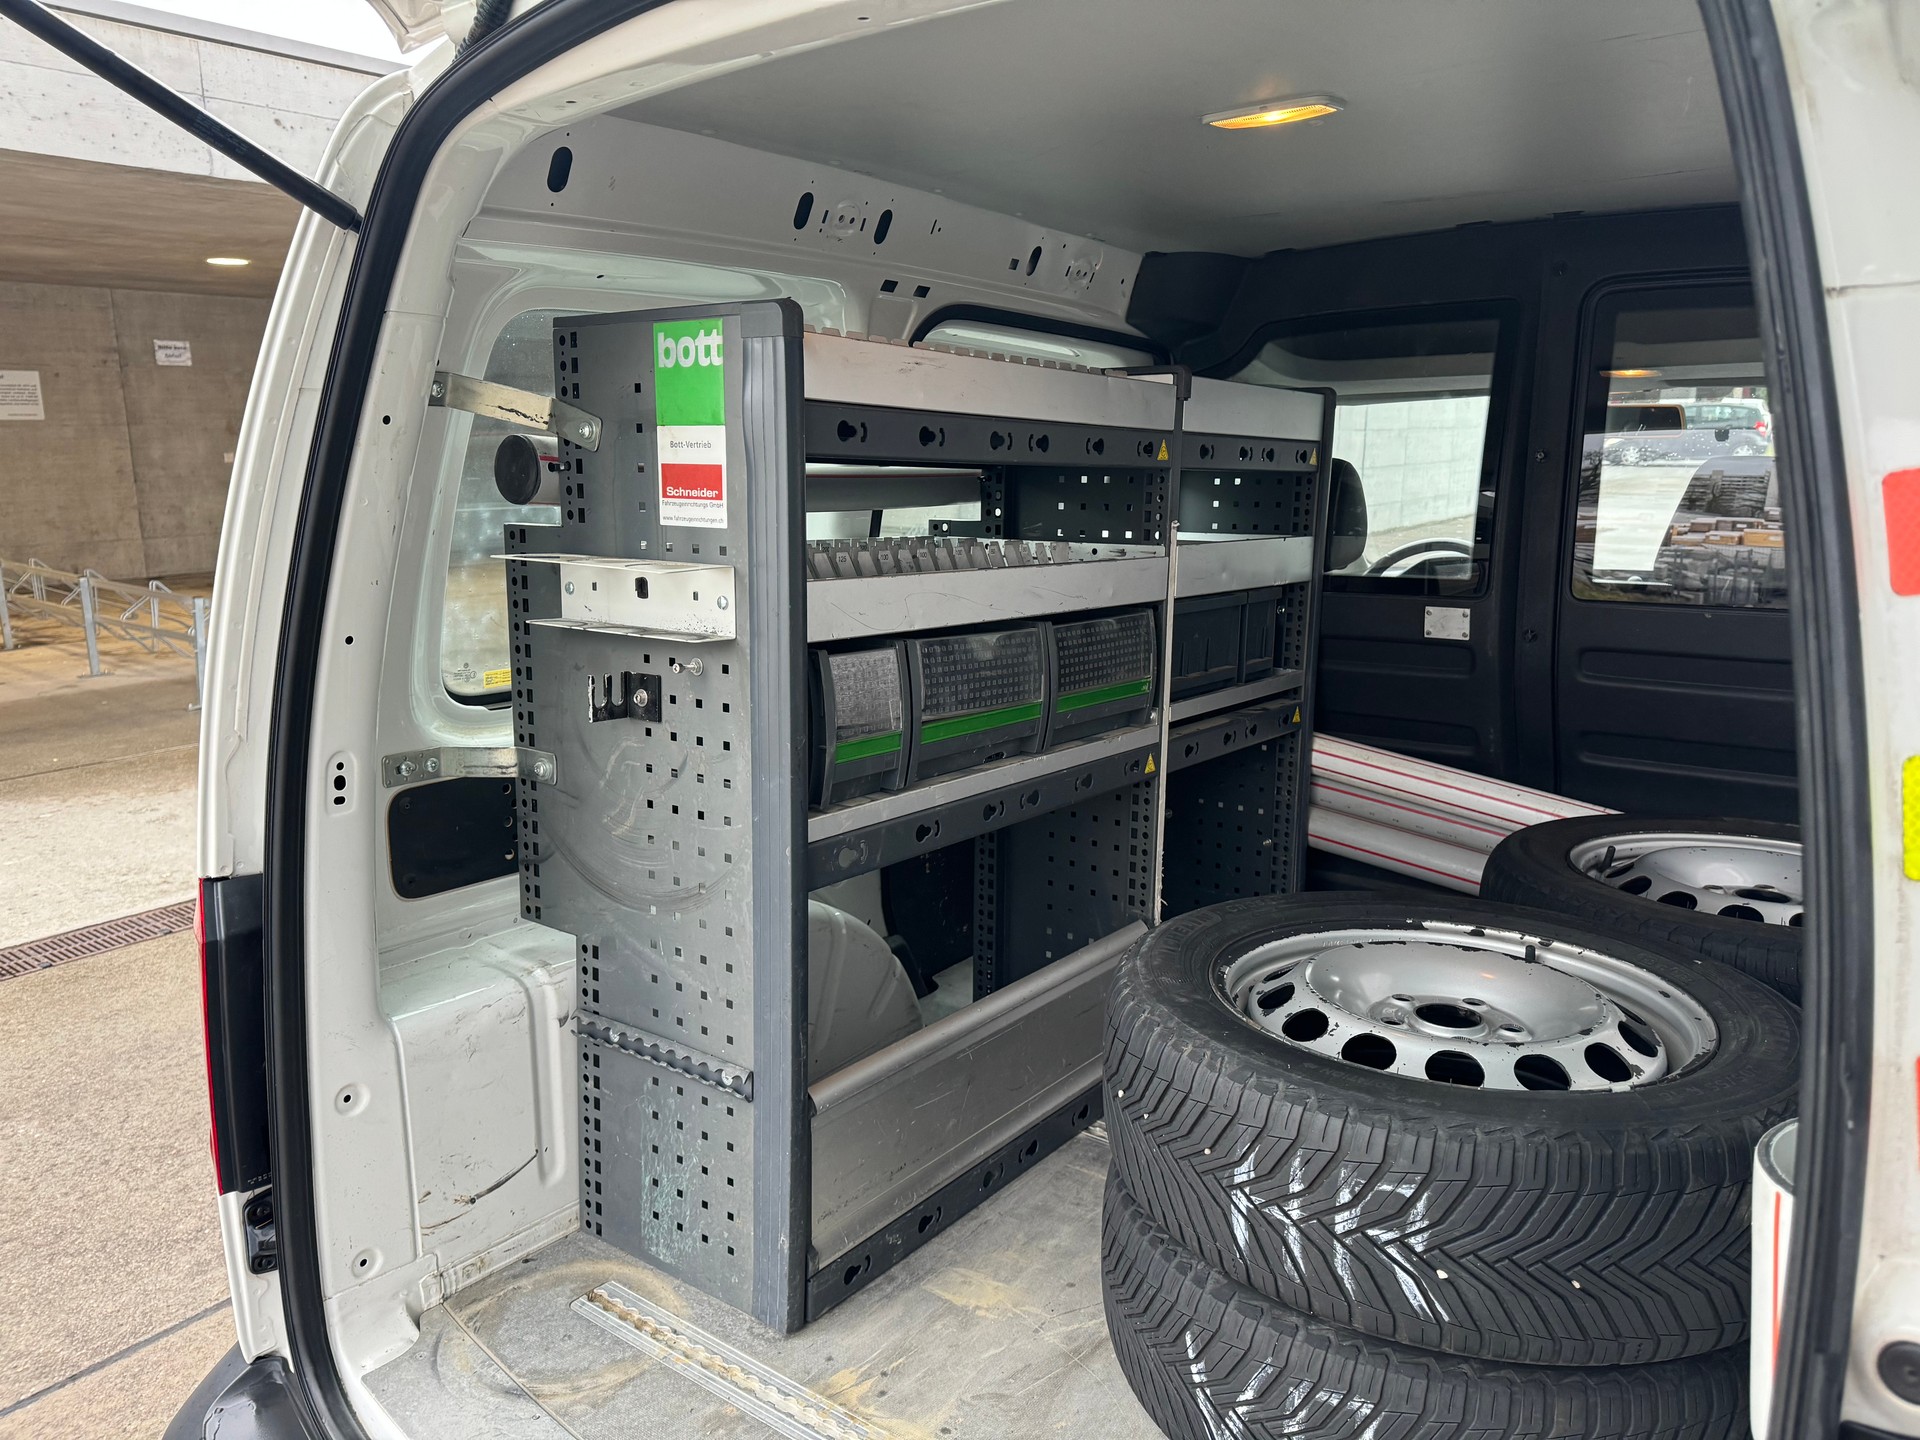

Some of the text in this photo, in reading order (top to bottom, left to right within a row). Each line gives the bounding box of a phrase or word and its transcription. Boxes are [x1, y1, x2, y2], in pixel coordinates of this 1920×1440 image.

[657, 329, 723, 368] bott
[669, 440, 712, 449] Bott-Vertrieb
[666, 486, 719, 498] Schneider
[838, 555, 847, 563] 125
